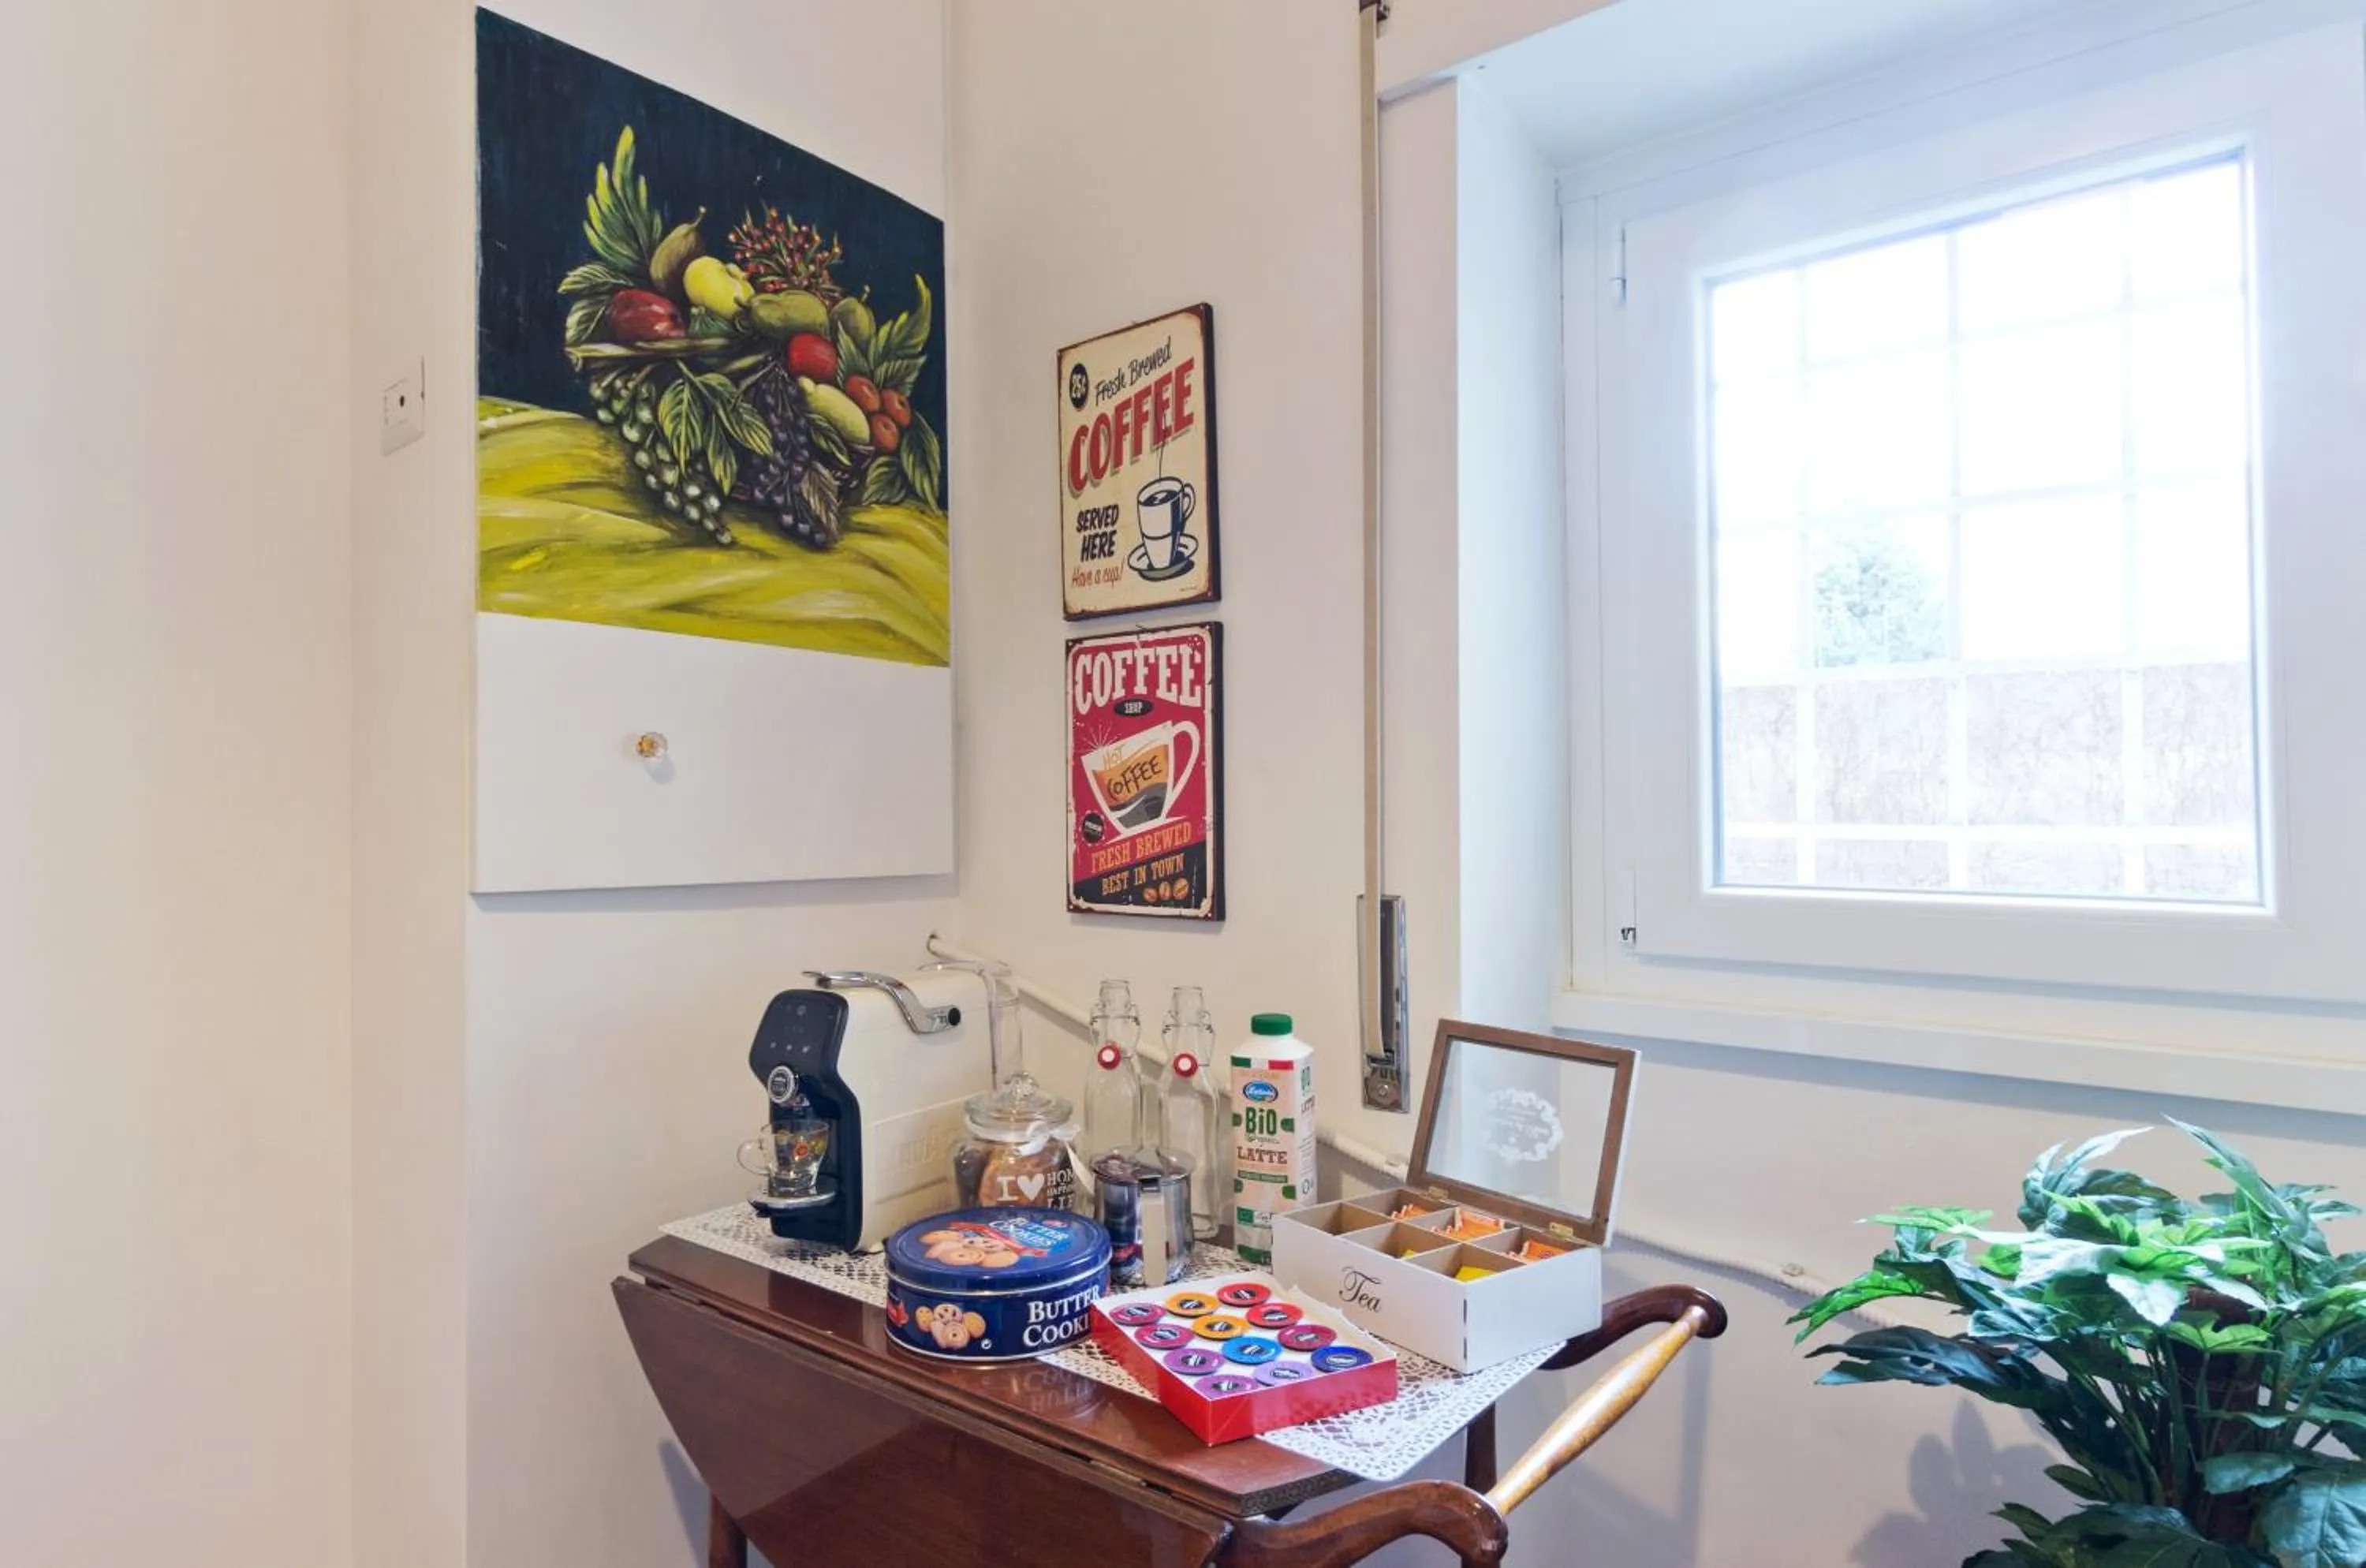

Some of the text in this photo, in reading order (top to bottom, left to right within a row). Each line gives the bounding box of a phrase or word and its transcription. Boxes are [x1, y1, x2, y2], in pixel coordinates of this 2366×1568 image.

[1128, 334, 1172, 386] Brewed
[1069, 357, 1195, 494] COFFEE
[1076, 504, 1119, 533] SERVED
[1080, 529, 1117, 562] HERE
[1075, 644, 1202, 715] COFFEE
[1091, 841, 1130, 874] FRESH
[1136, 820, 1192, 859] BREWED
[1101, 853, 1185, 896] BEST IN TOWN
[1236, 1146, 1288, 1164] LATTE
[996, 1175, 1020, 1201] I
[1028, 1285, 1101, 1324] BUTTER
[1338, 1266, 1383, 1313] Tea
[1023, 1312, 1089, 1347] COOKI
